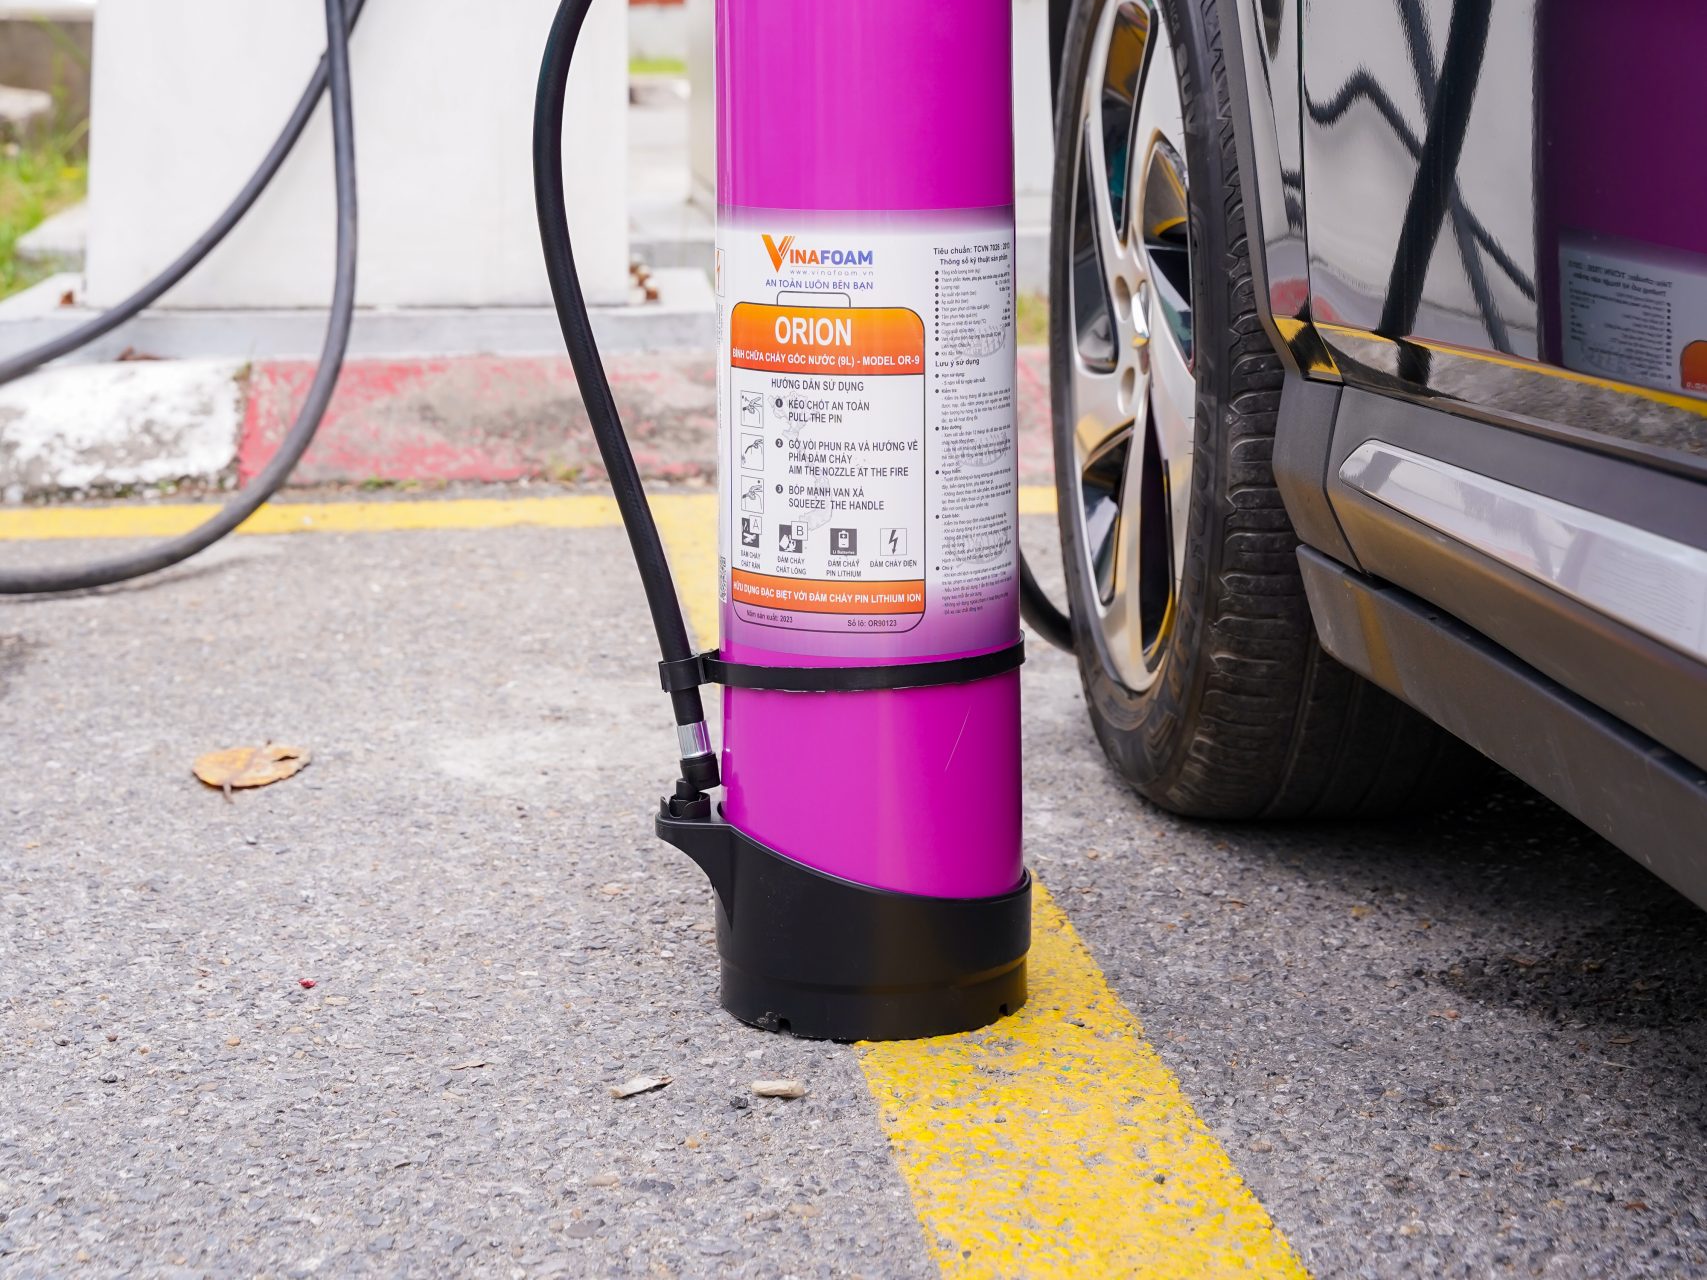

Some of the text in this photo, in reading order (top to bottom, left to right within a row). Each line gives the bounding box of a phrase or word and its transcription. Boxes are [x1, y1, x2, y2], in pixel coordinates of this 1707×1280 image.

[761, 234, 873, 273] VINAFOAM
[934, 247, 949, 255] Tiêu
[974, 245, 989, 253] TCVN
[940, 258, 960, 266] Thông
[961, 256, 969, 264] số
[970, 256, 977, 264] kỹ
[766, 278, 874, 292] AN TOÀN LUÔN BÊN BẠN
[775, 316, 852, 346] ORION
[732, 347, 745, 359] BÌNH
[745, 350, 764, 361] CHỮA
[765, 351, 786, 363] CHÁY
[787, 353, 806, 364] GỐC
[808, 354, 836, 365] NƯỚC
[838, 355, 855, 367] (9L)
[862, 356, 896, 366] MODEL
[897, 355, 920, 365] OR-9
[950, 360, 954, 368] ý
[771, 377, 864, 394] HƯỚNG DẪN SỬ DỤNG
[788, 398, 805, 410] KÉO
[806, 399, 830, 411] CHỐT
[831, 401, 844, 411] AN
[846, 400, 870, 411] TOÀN
[788, 411, 843, 424] PULL THE PIN
[803, 439, 816, 450] VÒI
[818, 441, 841, 451] PHUN
[844, 441, 856, 452] RA
[858, 440, 870, 452] VÀ
[872, 440, 905, 452] HƯỚNG
[907, 438, 919, 451] VỀ
[808, 452, 827, 463] ĐÁM
[828, 453, 853, 464] CHÁY
[788, 465, 909, 477] AIM THE NOZZLE AT THE FIRE
[788, 484, 805, 495] BÓP
[806, 486, 831, 499] MẠNH
[833, 487, 850, 497] VAN
[852, 486, 864, 498] XẢ
[788, 498, 884, 511] SQUEEZE THE HANDLE
[752, 518, 760, 530] A
[796, 525, 804, 536] B
[777, 555, 805, 565] ĐÁM CHÁY
[827, 559, 860, 568] ĐÁM CHÁY
[869, 559, 918, 568] ĐÁM CHÁY ĐIỆN
[775, 565, 790, 574] CHẤT
[825, 569, 862, 578] PIN LITHIUM
[744, 584, 760, 596] DỤNG
[760, 586, 775, 599] ĐẶC
[776, 589, 792, 601] BIỆT
[793, 589, 808, 601] VỚI
[809, 591, 827, 602] ĐÁM
[829, 592, 853, 603] CHÁY
[854, 594, 869, 604] PIN
[871, 594, 905, 604] LITHIUM
[907, 593, 922, 602] ION
[757, 611, 766, 619] sản
[780, 614, 793, 623] 2023
[847, 617, 897, 627] Số lô: OR90123
